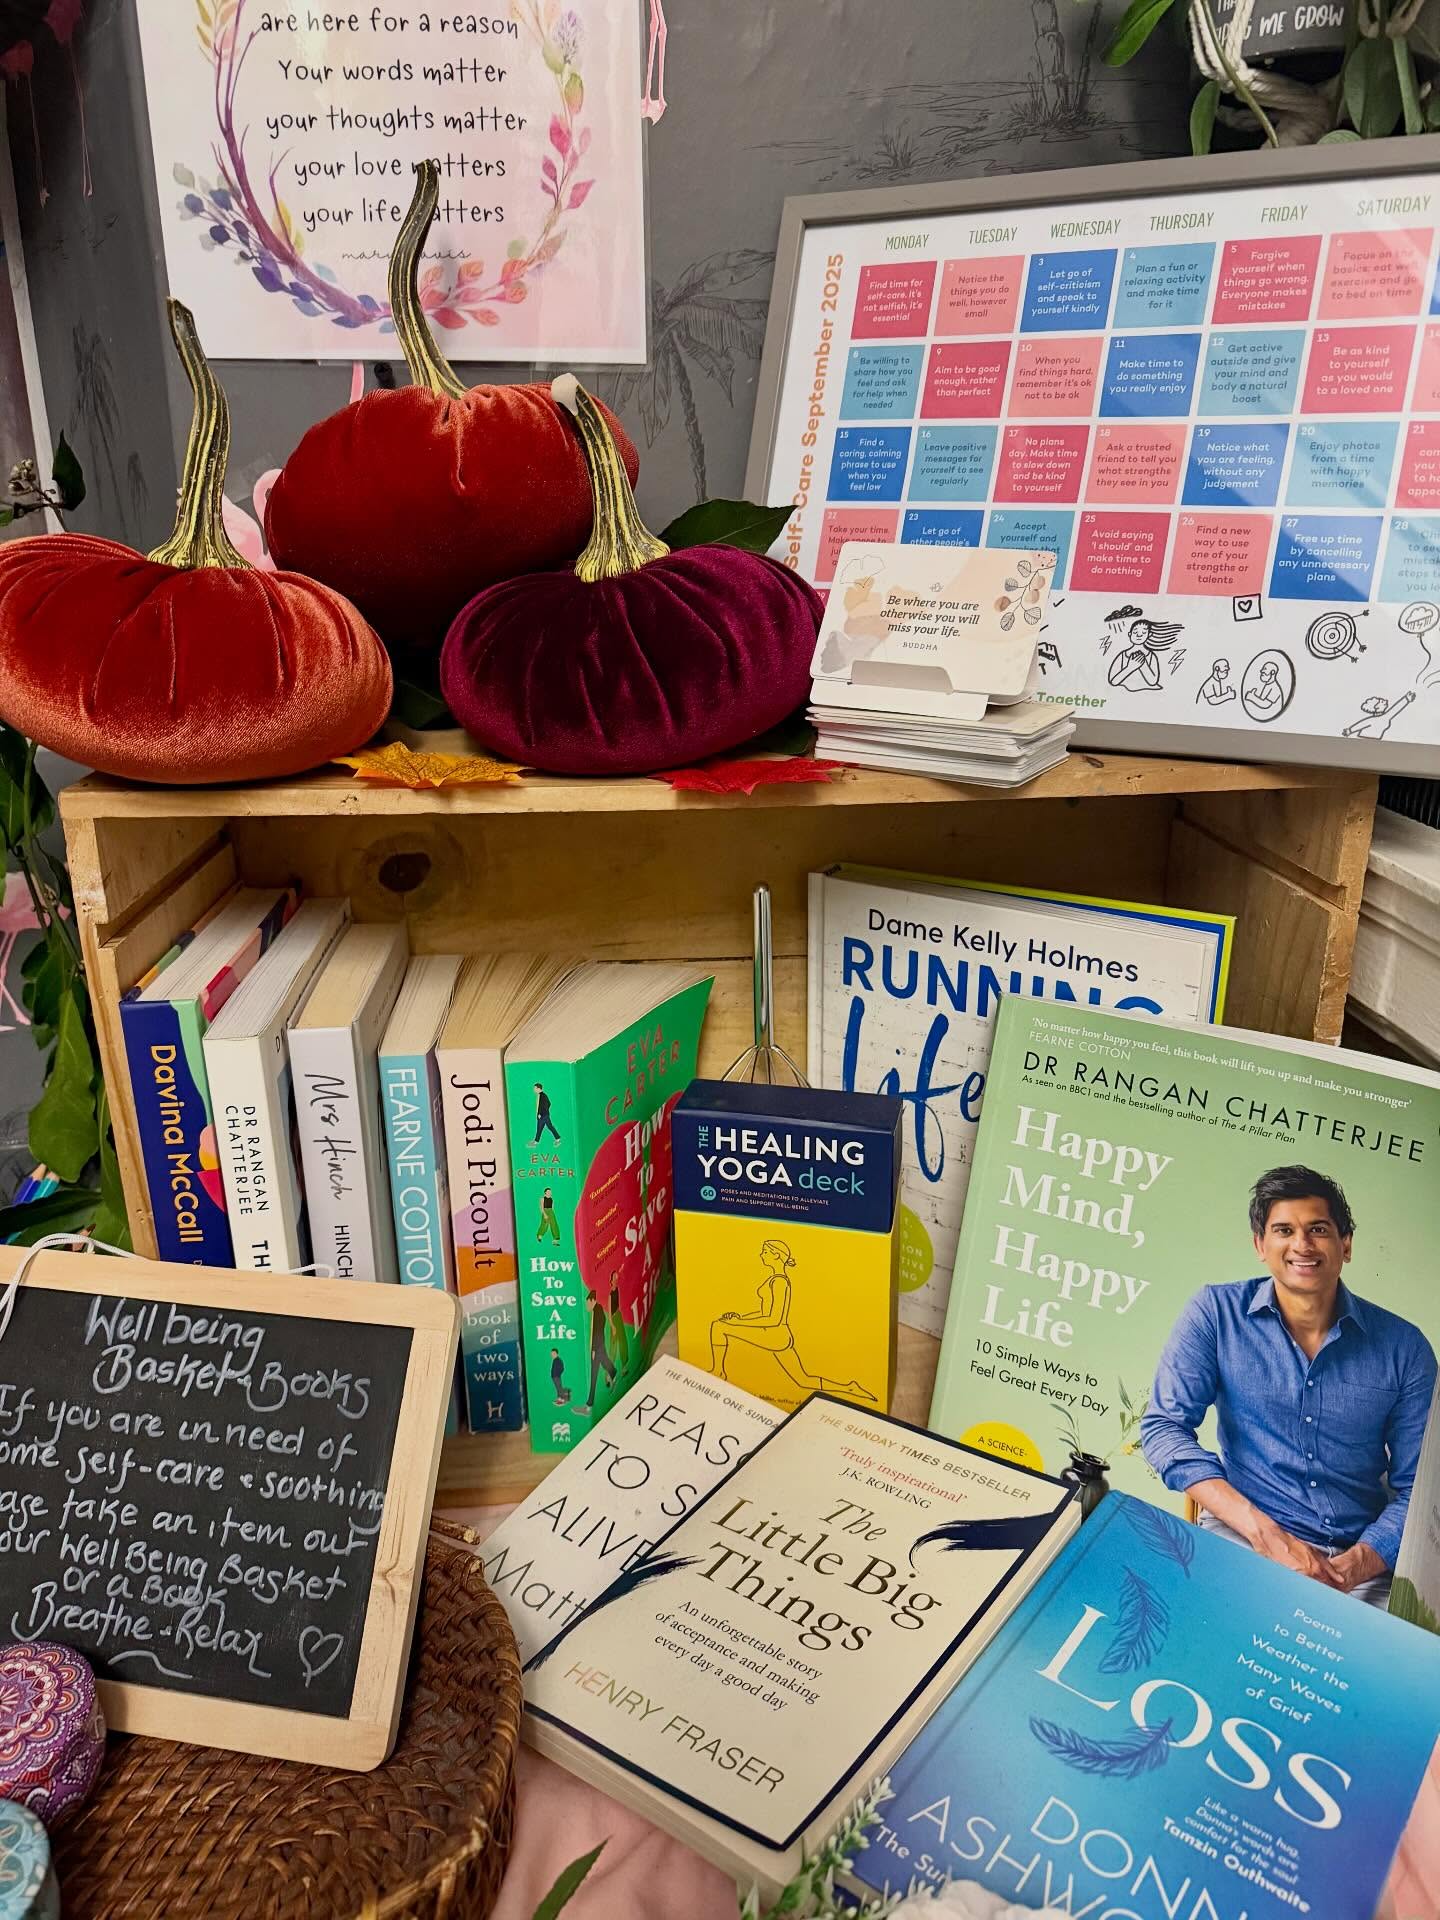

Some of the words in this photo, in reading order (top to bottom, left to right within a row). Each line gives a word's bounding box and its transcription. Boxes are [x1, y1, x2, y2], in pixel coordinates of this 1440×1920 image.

[260, 13, 298, 32] are
[307, 9, 359, 32] here
[368, 9, 409, 33] for
[419, 13, 432, 33] a
[440, 15, 519, 39] reason
[1259, 11, 1287, 37] ME
[1294, 4, 1344, 31] GROW
[277, 59, 334, 82] Your
[343, 59, 413, 81] words
[423, 57, 508, 85] matter
[266, 112, 319, 138] your
[327, 106, 435, 137] thoughts
[443, 108, 528, 133] matter
[295, 158, 346, 185] your
[354, 151, 401, 176] love
[304, 204, 352, 232] your
[361, 199, 401, 223] life
[1150, 212, 1214, 232] THURSDAY
[1261, 205, 1308, 223] FRIDAY
[1357, 195, 1431, 217] SATURDAY
[885, 234, 930, 251] MONDAY
[969, 227, 1018, 244] TUESDAY
[1051, 219, 1120, 239] WEDNESDAY
[1116, 372, 1129, 381] do
[1130, 371, 1183, 382] something
[1119, 360, 1146, 369] Make
[1148, 359, 1171, 368] time
[1173, 360, 1184, 368] to
[1110, 386, 1128, 395] you
[1129, 384, 1157, 395] really
[1159, 383, 1187, 394] enjoy
[784, 454, 813, 568] Self-Care
[801, 318, 834, 446] September
[822, 253, 844, 312] 2025
[1290, 546, 1304, 557] by
[1306, 547, 1362, 559] cancelling
[1294, 534, 1318, 543] Free
[1320, 536, 1335, 545] up
[1337, 535, 1362, 544] time
[1278, 560, 1299, 569] any
[1301, 561, 1370, 572] unnecessary
[1306, 572, 1336, 582] plans
[880, 608, 933, 621] otherwise
[935, 614, 956, 623] you
[958, 614, 981, 625] will
[887, 594, 901, 605] Be
[903, 596, 937, 608] where
[939, 601, 960, 610] you
[961, 602, 980, 611] are
[887, 623, 912, 633] miss
[913, 626, 940, 635] your
[940, 625, 961, 638] life.
[903, 641, 938, 651] BUDDHA
[868, 908, 944, 944] Dame
[953, 925, 1018, 963] Kelly
[1027, 938, 1140, 983] Holmes
[151, 1044, 184, 1145] Davina
[304, 1073, 345, 1128] Mrs
[450, 1074, 494, 1147] Jodi
[1023, 1052, 1057, 1076] DR
[1074, 1062, 1209, 1110] RANGAN
[1226, 1096, 1425, 1163] CHATTERJEE
[242, 1106, 258, 1128] DR
[387, 1068, 426, 1177] FEARNE
[225, 1105, 253, 1215] CHATTERJEE
[530, 1153, 561, 1166] EVA
[698, 1125, 710, 1149] THE
[715, 1126, 865, 1166] HEALING
[1011, 1105, 1174, 1189] Happy
[248, 1136, 270, 1212] RANGAN
[313, 1136, 357, 1201] Hinch
[517, 1168, 575, 1180] CARTER
[697, 1154, 793, 1187] YOGA
[798, 1167, 865, 1196] deck
[166, 1153, 204, 1243] McCall
[702, 1189, 715, 1199] 60
[1000, 1164, 1145, 1249] Mind,
[467, 1158, 503, 1271] Picoult
[334, 1225, 354, 1279] HINCH
[530, 1258, 576, 1273] How
[989, 1223, 1151, 1315] Happy
[472, 1291, 504, 1306] the
[531, 1292, 577, 1307] Save
[543, 1276, 564, 1290] To
[467, 1309, 511, 1327] book
[536, 1324, 577, 1341] Life
[548, 1309, 562, 1321] A
[979, 1283, 1074, 1348] Life
[479, 1328, 501, 1346] of
[476, 1349, 509, 1365] two
[975, 1338, 992, 1355] 10
[995, 1345, 1040, 1370] Simple
[1044, 1358, 1081, 1383] Ways
[1085, 1371, 1098, 1387] to
[473, 1367, 515, 1385] ways
[970, 1361, 995, 1379] Feel
[998, 1368, 1037, 1392] Great
[1040, 1382, 1078, 1408] Every
[1081, 1394, 1110, 1417] Day
[34, 1400, 101, 1449] you
[110, 1412, 165, 1438] are
[226, 1426, 305, 1456] need
[317, 1433, 358, 1473] of
[584, 1439, 650, 1490] TO
[818, 1414, 842, 1428] THE
[844, 1424, 898, 1449] SUNDAY
[899, 1444, 941, 1466] TIMES
[942, 1462, 1032, 1501] BESTSELLER
[59, 1488, 139, 1535] take
[152, 1511, 198, 1535] an
[209, 1506, 292, 1548] item
[303, 1529, 369, 1557] out
[819, 1497, 888, 1543] The
[218, 1553, 347, 1605] Basket
[710, 1497, 838, 1578] Little
[845, 1549, 943, 1630] Big
[63, 1566, 100, 1594] or
[106, 1573, 133, 1599] a
[697, 1540, 873, 1653] Things
[678, 1600, 699, 1617] An
[700, 1612, 786, 1662] unforgettable
[786, 1654, 823, 1681] story
[1293, 1608, 1343, 1639] Poems
[655, 1612, 675, 1624] of
[670, 1620, 739, 1660] acceptance
[739, 1656, 769, 1676] and
[766, 1670, 821, 1705] making
[1274, 1624, 1289, 1637] to
[1295, 1632, 1345, 1663] Better
[654, 1634, 691, 1659] every
[690, 1653, 716, 1673] day
[714, 1668, 723, 1677] a
[722, 1672, 763, 1697] good
[762, 1690, 789, 1712] day
[1252, 1633, 1318, 1675] Weather
[1323, 1671, 1350, 1691] the
[1237, 1653, 1282, 1685] Many
[1290, 1677, 1342, 1714] Waves
[1033, 1603, 1351, 1830] LOSS
[1245, 1687, 1266, 1700] of
[1269, 1696, 1313, 1724] Grief
[562, 1661, 663, 1723] HENRY
[662, 1715, 785, 1794] FRASER
[1163, 1816, 1218, 1859] Tamzin
[1224, 1854, 1312, 1913] Outhwaite
